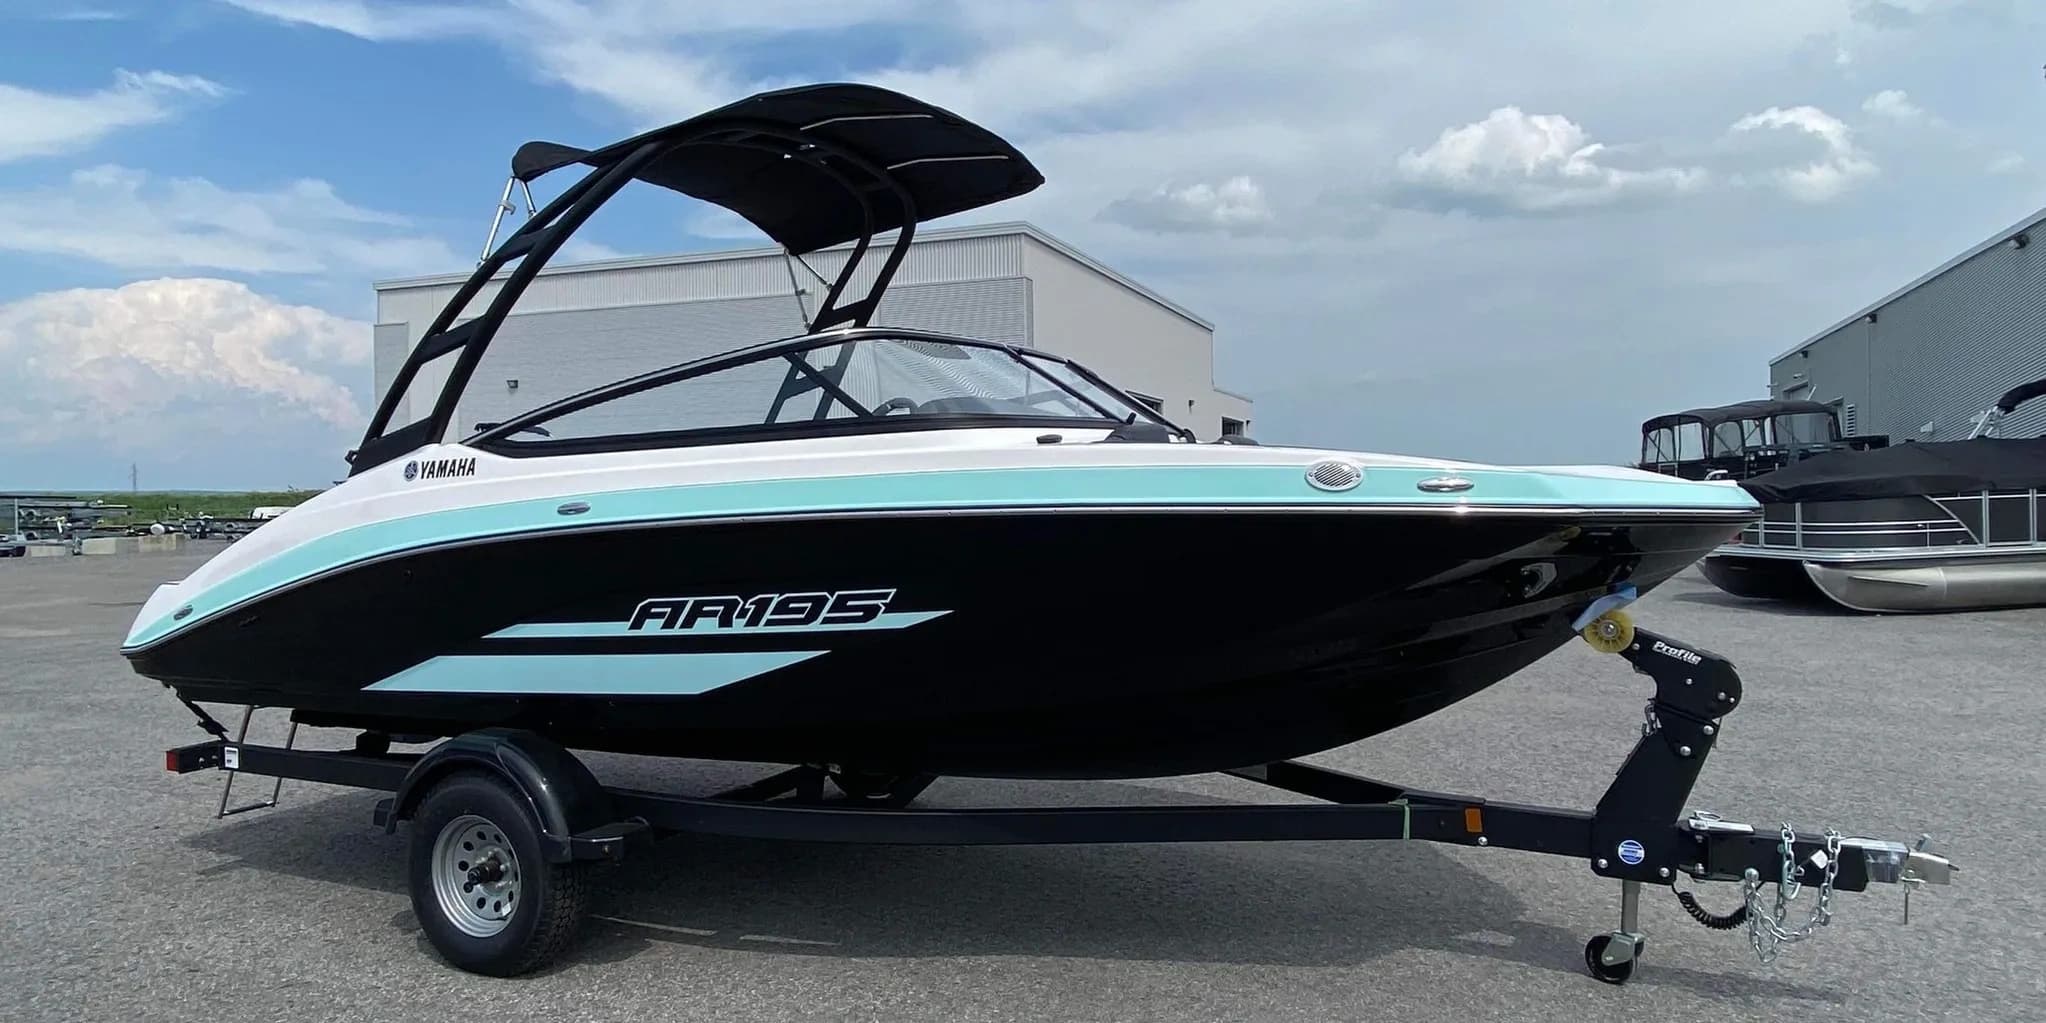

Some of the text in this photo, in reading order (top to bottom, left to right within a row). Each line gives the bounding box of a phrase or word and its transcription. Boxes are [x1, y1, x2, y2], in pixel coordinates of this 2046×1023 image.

[420, 457, 476, 479] YAMAHA
[627, 588, 897, 631] AR195
[1653, 641, 1702, 663] Profile
